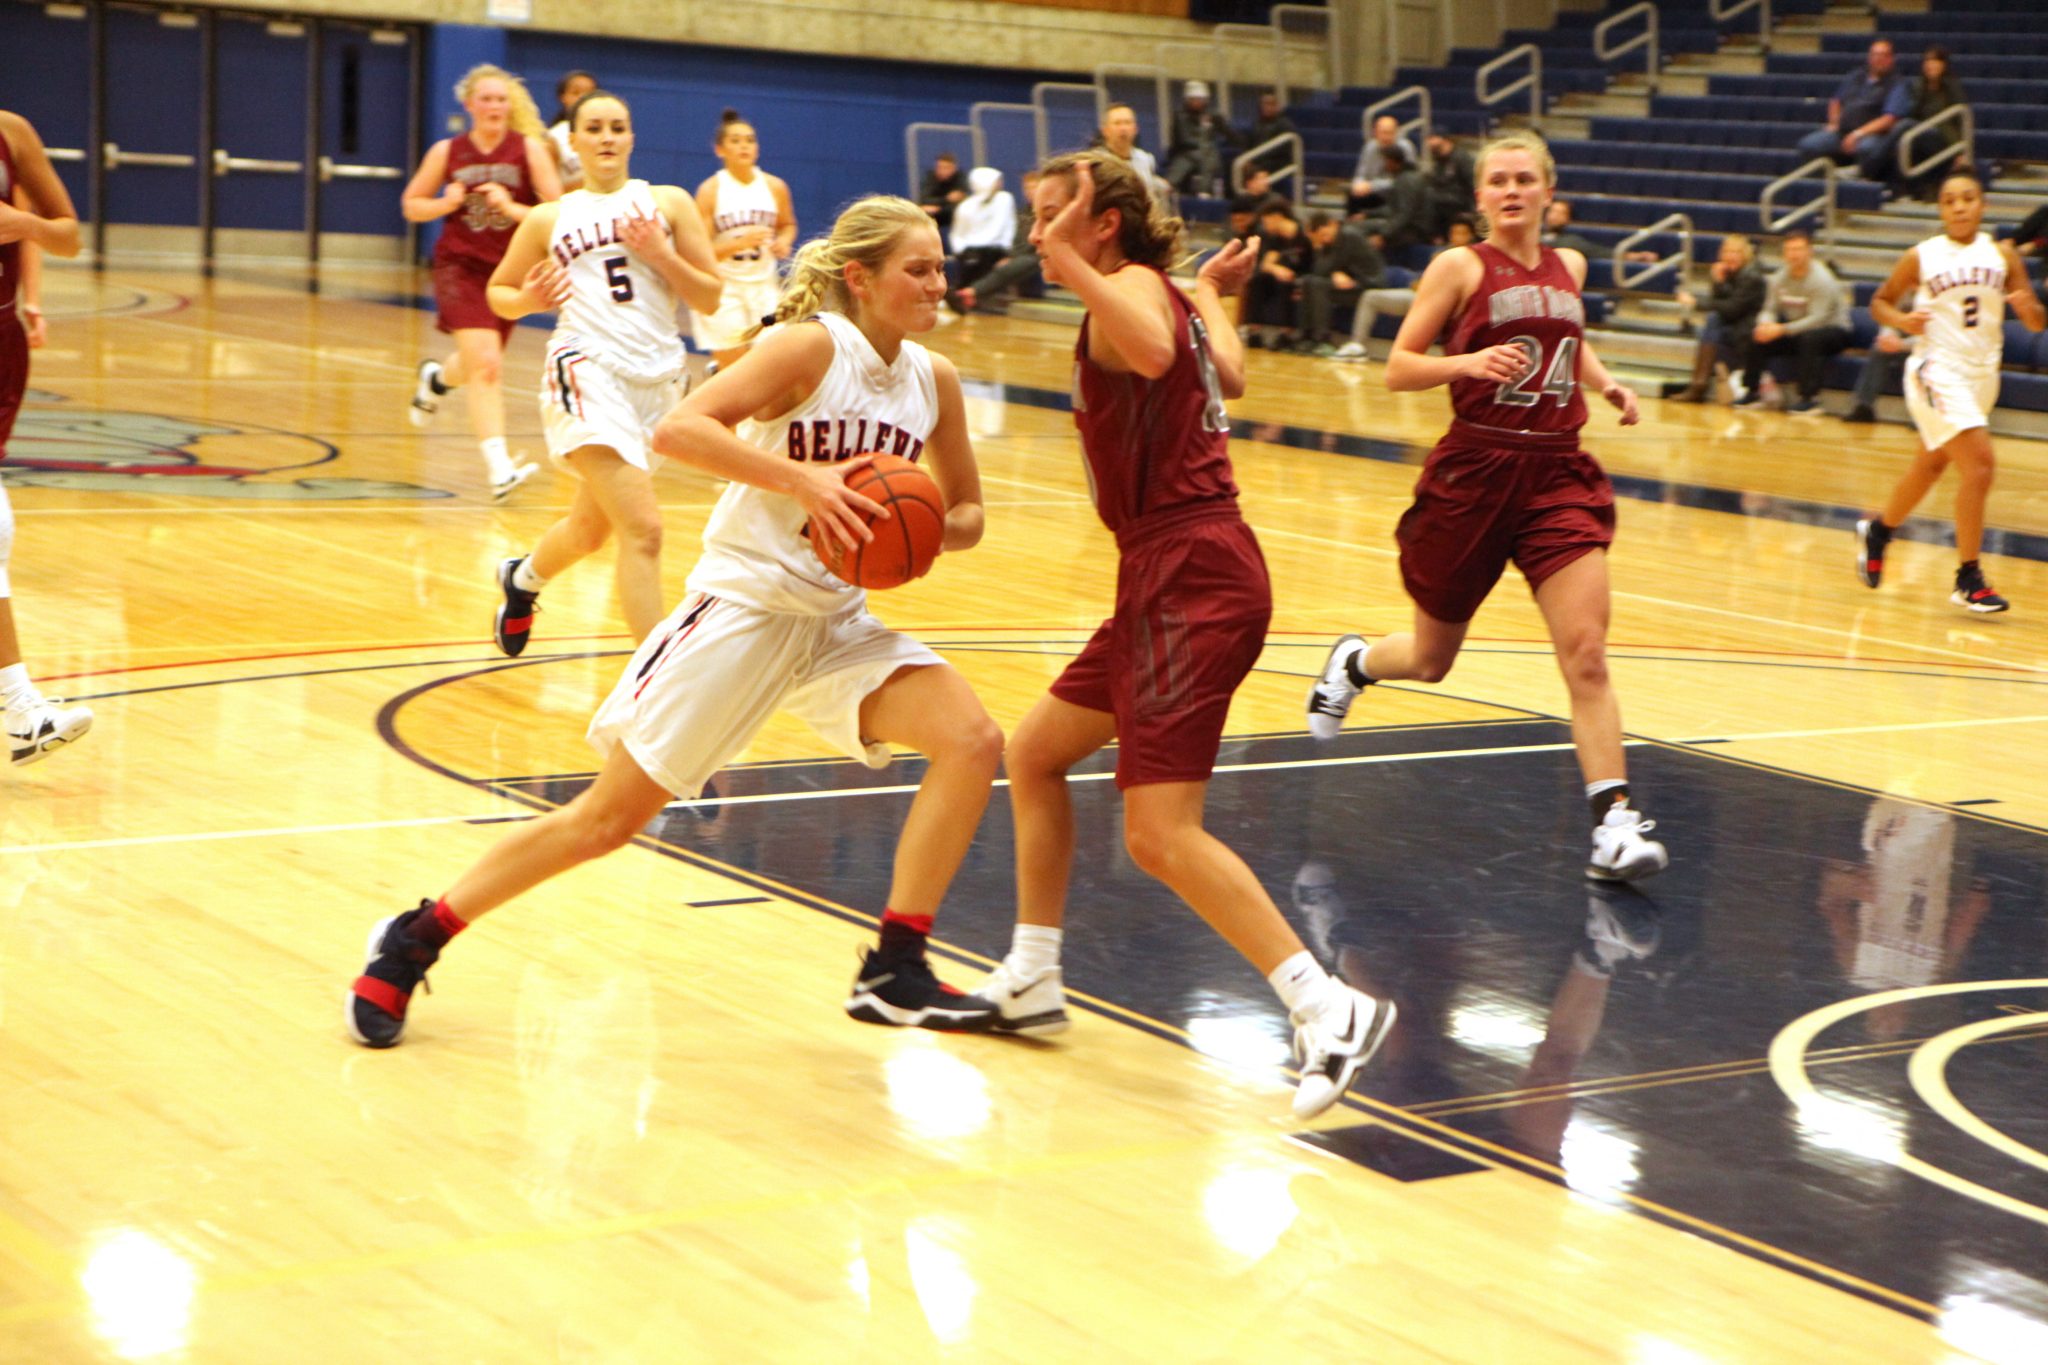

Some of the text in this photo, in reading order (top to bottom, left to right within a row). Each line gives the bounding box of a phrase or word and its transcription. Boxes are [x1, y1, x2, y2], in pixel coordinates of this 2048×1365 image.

[604, 256, 634, 303] 5
[1963, 296, 1980, 328] 2
[1493, 335, 1580, 409] 24
